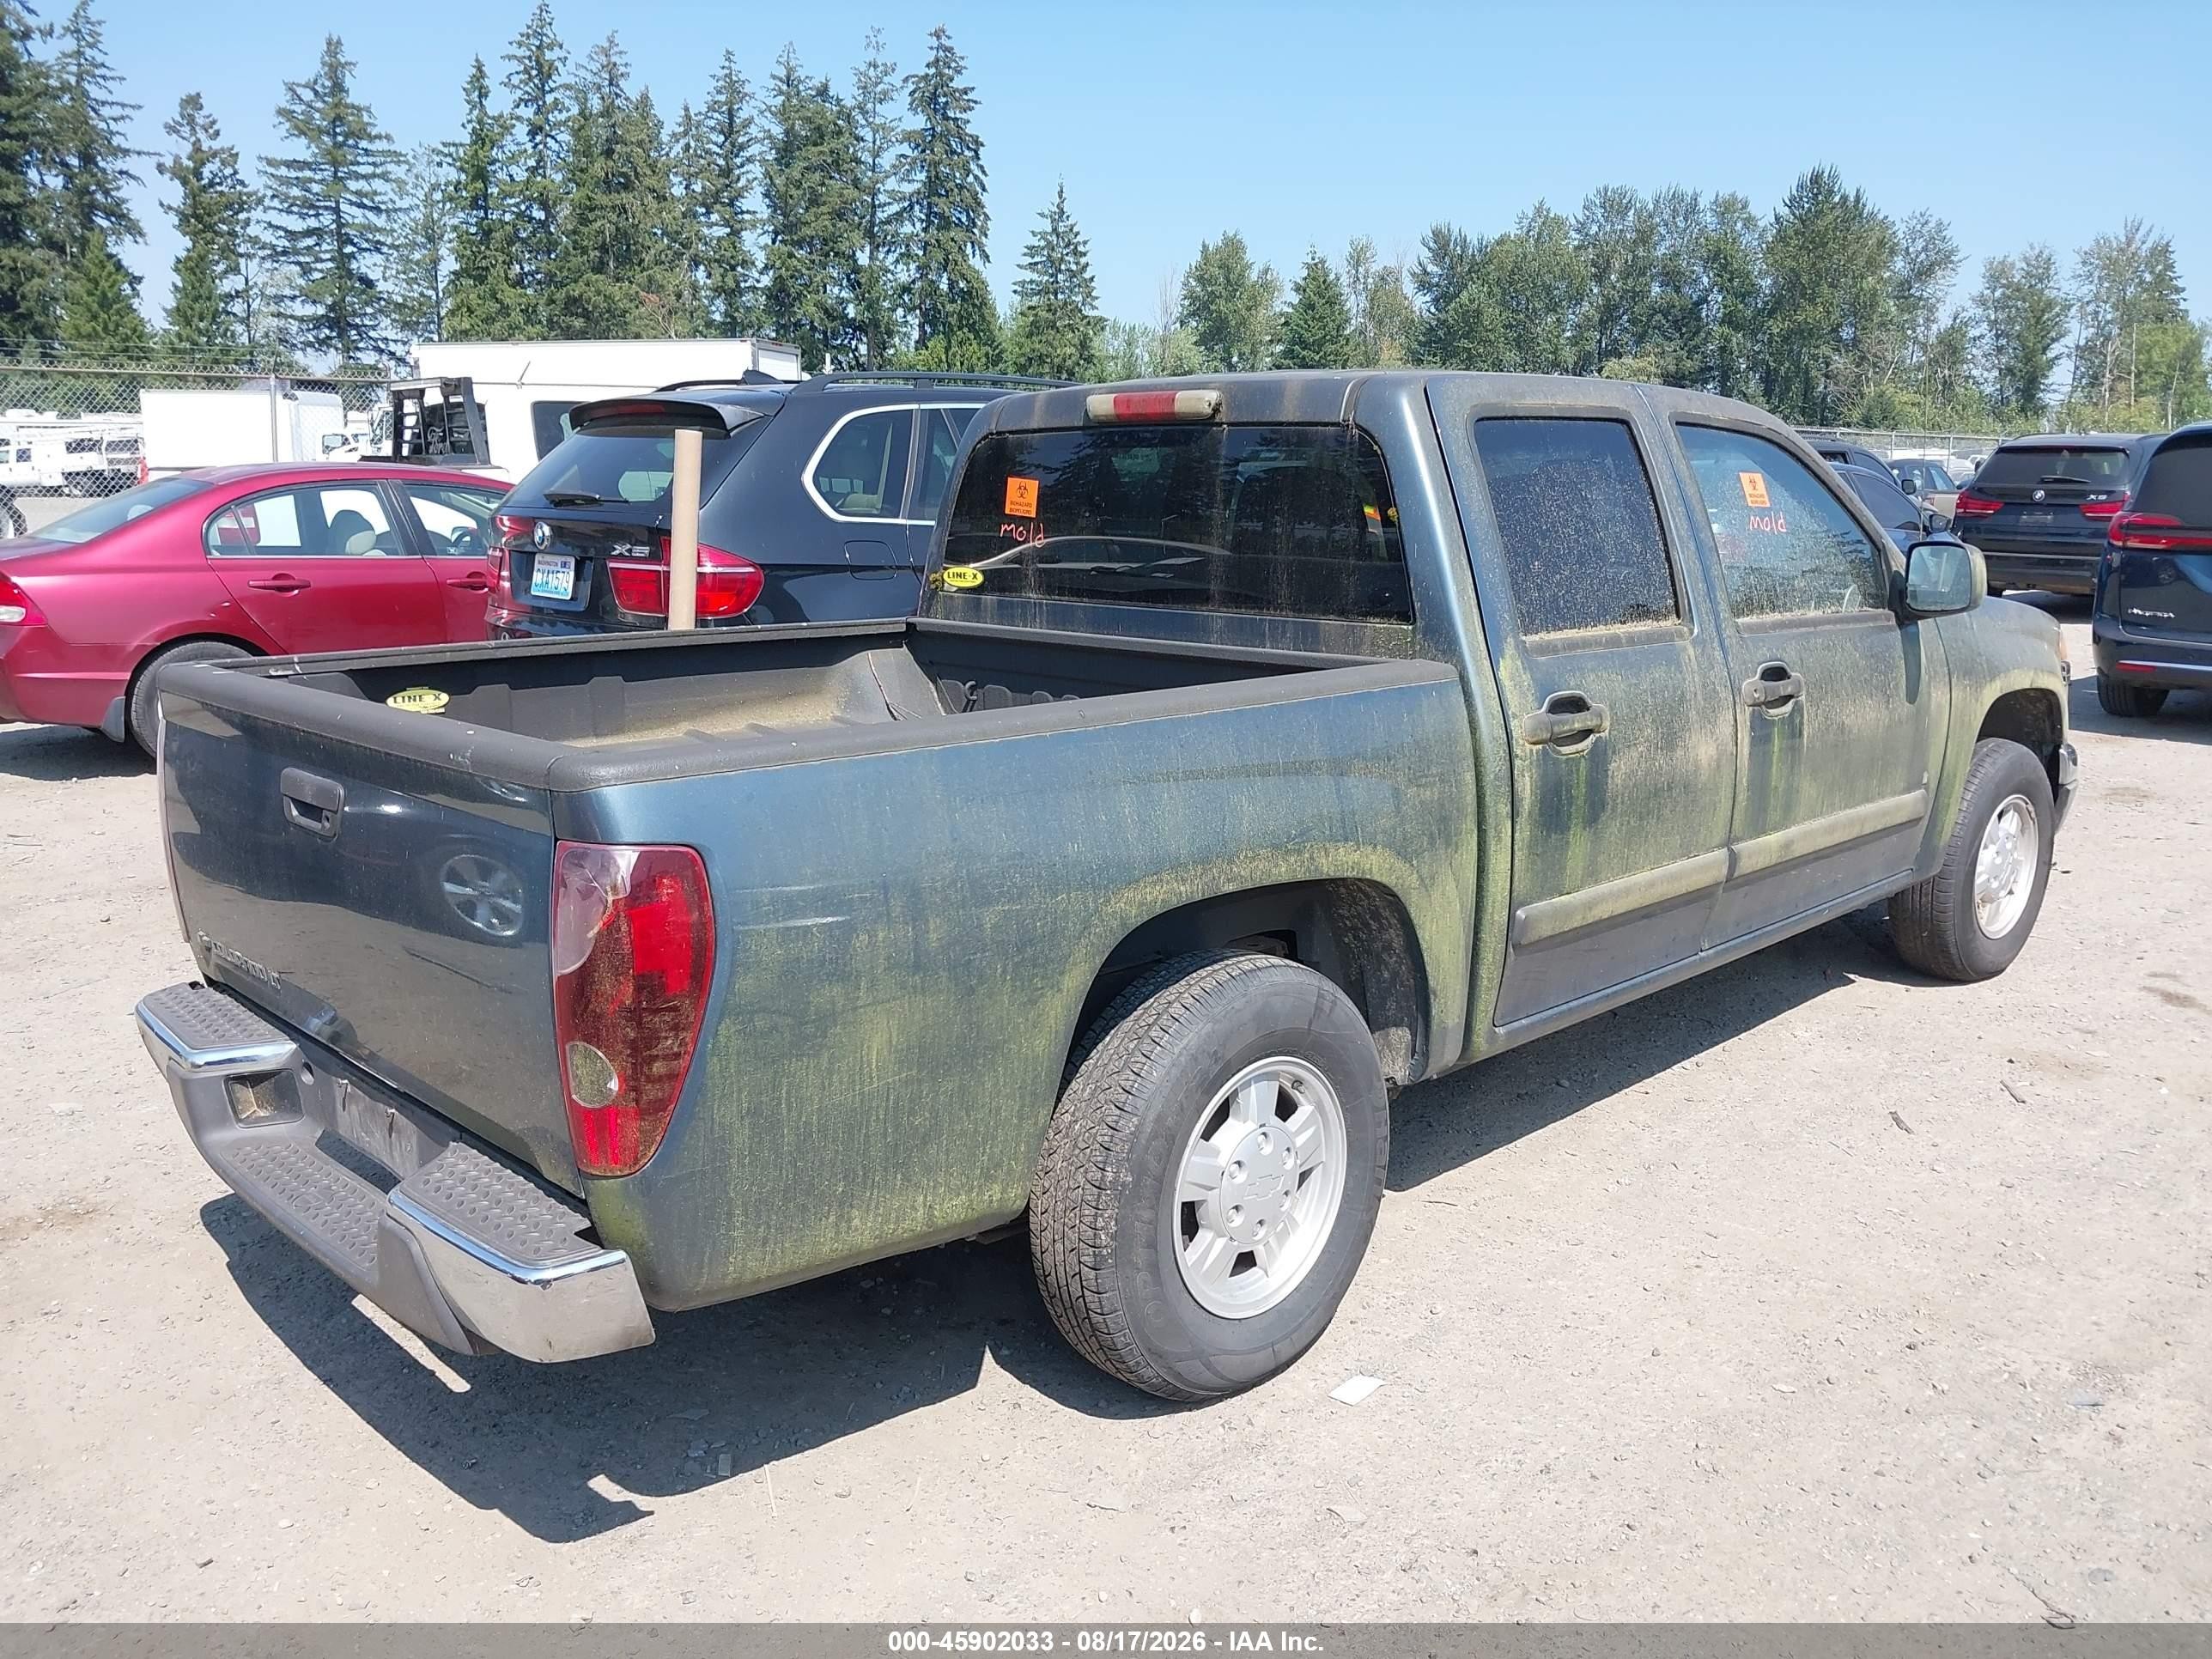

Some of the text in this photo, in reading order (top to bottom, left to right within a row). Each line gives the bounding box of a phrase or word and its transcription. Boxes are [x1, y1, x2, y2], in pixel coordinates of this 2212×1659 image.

[1000, 522, 1045, 548] mold
[1750, 511, 1787, 535] mold
[534, 568, 570, 592] CXA1579
[947, 571, 978, 580] LINE-X
[393, 693, 442, 703] LINEX
